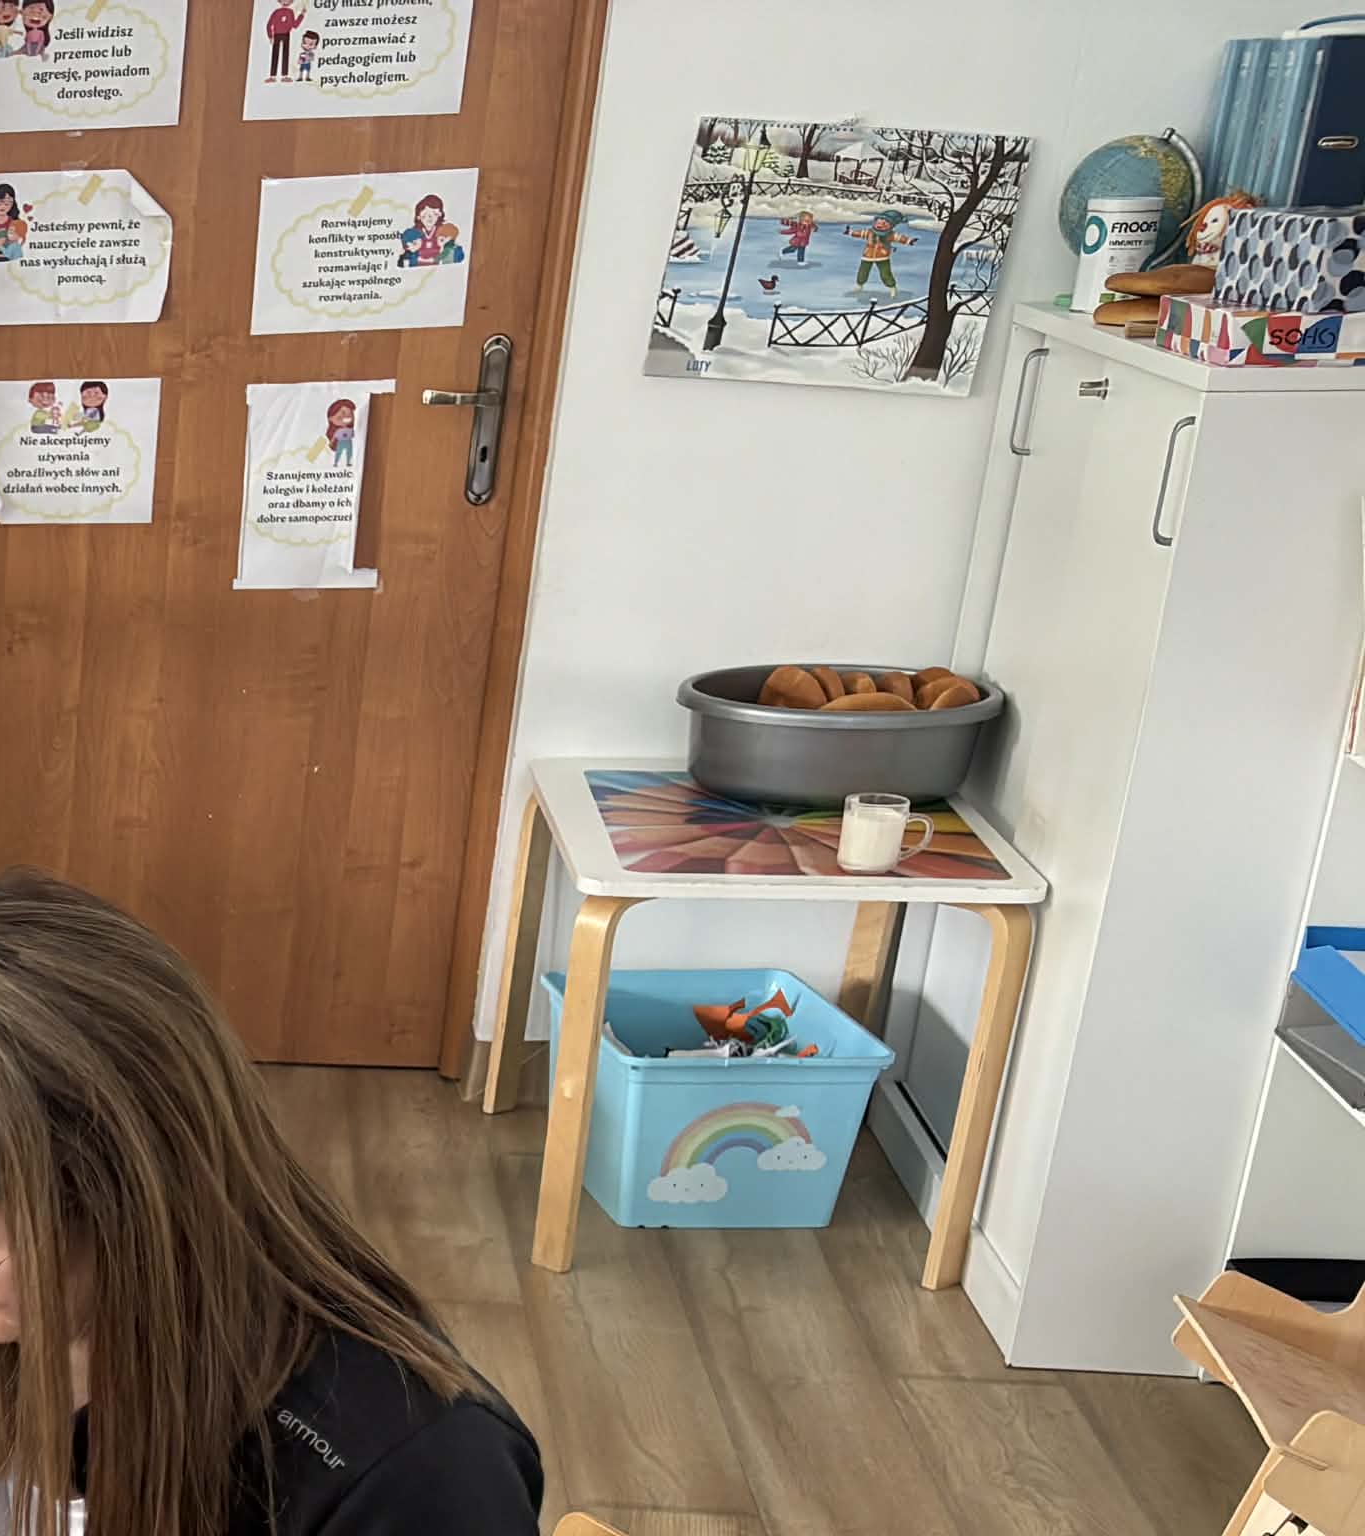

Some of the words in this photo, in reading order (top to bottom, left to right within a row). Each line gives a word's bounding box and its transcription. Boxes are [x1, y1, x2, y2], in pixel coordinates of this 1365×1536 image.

[314, 0, 339, 11] Gdy
[325, 18, 369, 27] zawsze
[371, 14, 418, 25] możesz
[55, 27, 84, 40] Jeśli
[87, 25, 133, 38] widzisz
[322, 33, 406, 49] porozmawiać
[409, 34, 416, 43] z
[54, 49, 109, 62] przemoc
[112, 45, 132, 57] lub
[318, 53, 393, 68] pedagogiem
[396, 51, 417, 63] lub
[33, 69, 82, 83] agresję,
[85, 65, 150, 81] powiadom
[320, 71, 409, 88] psychologiem.
[57, 86, 123, 100] dorosłego.
[31, 220, 85, 233] Jesteśmy
[88, 219, 126, 232] pewni,
[129, 219, 141, 229] że
[321, 217, 394, 229] Rozwiązujemy
[29, 238, 97, 251] nauczyciele
[99, 238, 141, 248] zawsze
[309, 232, 355, 245] konflikty
[314, 247, 395, 259] konstruktywny,
[20, 258, 41, 267] nas
[43, 254, 108, 269] wysłuchają
[116, 254, 146, 266] służą
[318, 261, 383, 274] rozmawiając
[57, 273, 107, 286] pomocą.
[302, 277, 347, 290] szukając
[348, 276, 402, 287] wspólnego
[20, 436, 38, 446] Nie
[39, 435, 111, 448] akceptujemy
[38, 451, 90, 464] używania
[6, 467, 73, 480] obraźliwych
[75, 467, 100, 477] słów
[102, 467, 120, 477] ani
[266, 470, 322, 482] Szanujemy
[3, 483, 43, 494] działań
[45, 483, 79, 493] wobec
[81, 482, 122, 495] innych.
[263, 485, 304, 497] kolegów
[268, 500, 291, 509] oraz
[292, 498, 327, 510] dbamy
[337, 498, 352, 508] ich
[257, 514, 287, 524] dobre
[277, 1409, 346, 1470] armour
